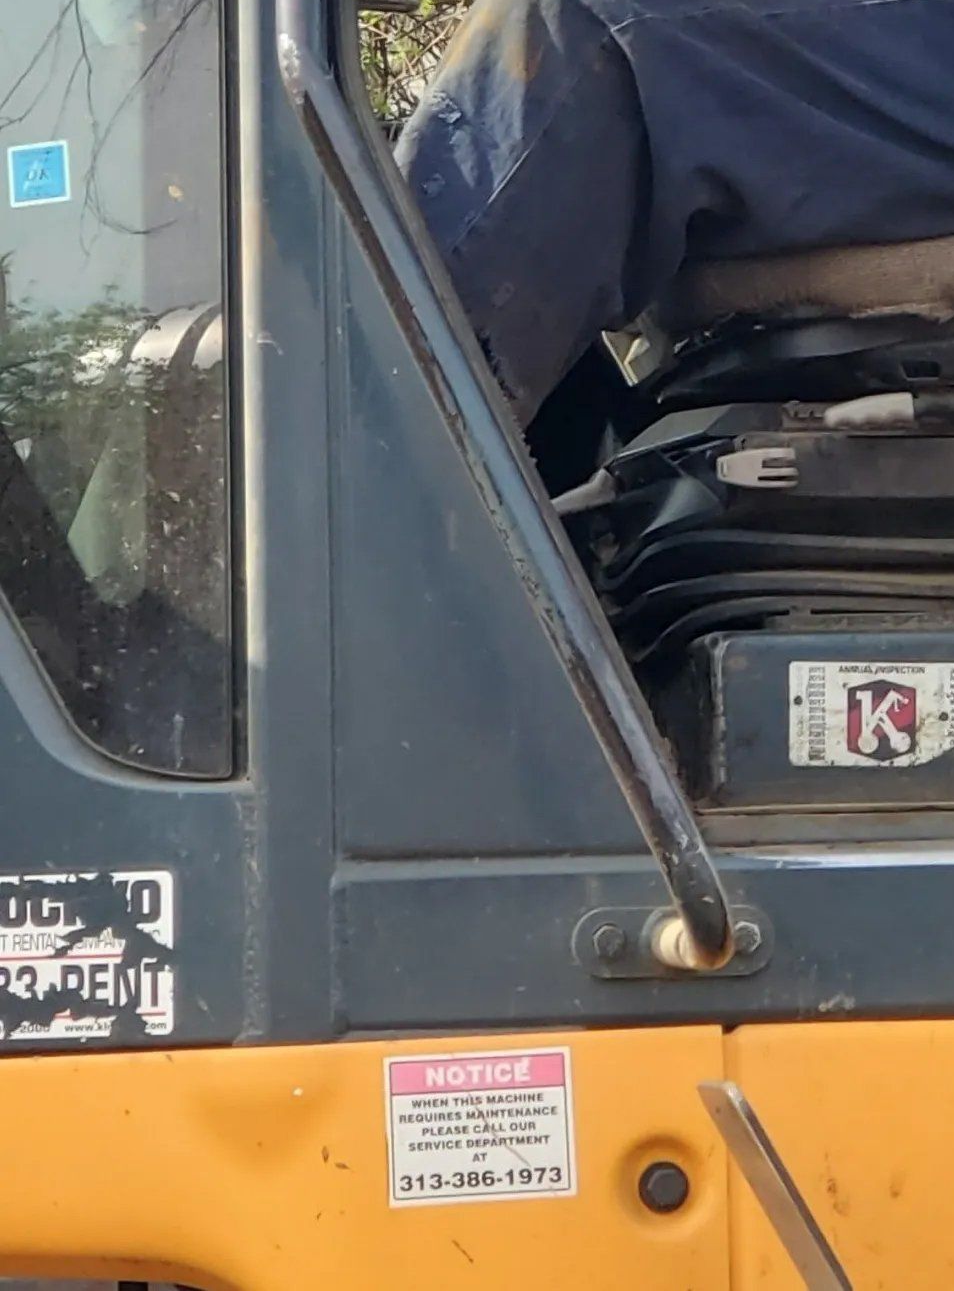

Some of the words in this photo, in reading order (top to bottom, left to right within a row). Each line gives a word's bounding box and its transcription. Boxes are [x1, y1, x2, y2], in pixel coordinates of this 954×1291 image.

[425, 1063, 531, 1087] NOTICE
[412, 1097, 449, 1108] WHEN
[453, 1096, 483, 1106] THIS
[486, 1093, 544, 1104] MACHINE
[399, 1111, 462, 1123] REQUIRES
[466, 1106, 557, 1120] MAINTENANCE
[422, 1124, 469, 1136] PLEASE
[473, 1123, 506, 1134] CALL
[510, 1121, 536, 1131] OUR
[408, 1140, 463, 1152] SERVICE
[466, 1135, 550, 1149] DEPARTMENT
[472, 1152, 488, 1162] AT
[399, 1167, 562, 1192] 313-386-1973
